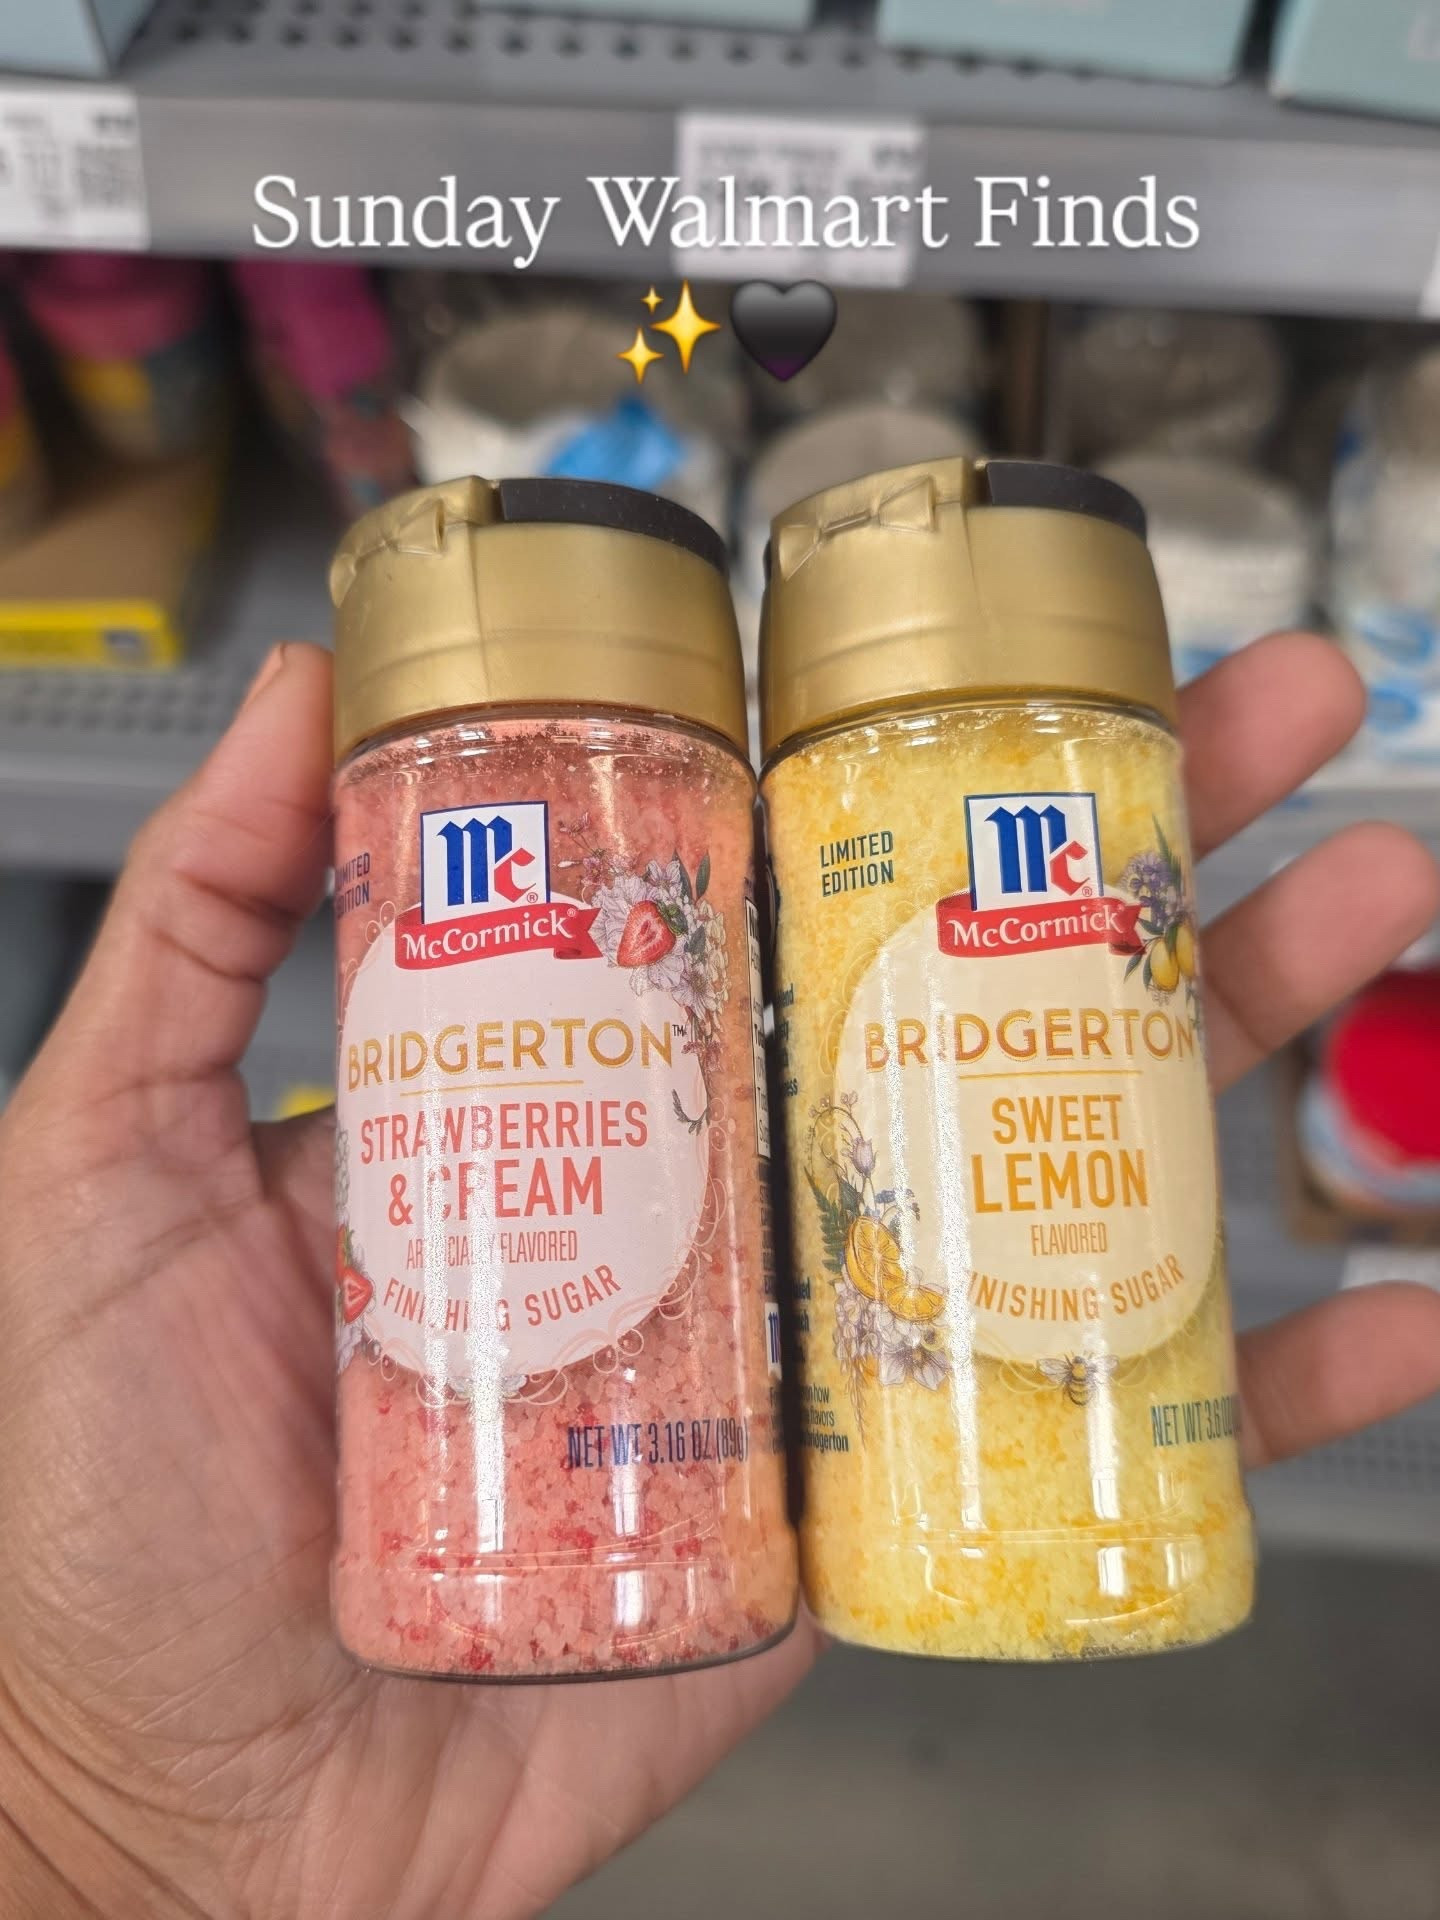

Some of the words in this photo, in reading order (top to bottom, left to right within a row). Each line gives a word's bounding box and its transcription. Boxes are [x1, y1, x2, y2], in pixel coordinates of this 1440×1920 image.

[819, 830, 895, 868] LIMITED
[822, 863, 895, 898] EDITION
[864, 1008, 1195, 1074] BRIDGERTON
[360, 1100, 648, 1165] STRAWBERRIES
[991, 1093, 1123, 1145] SWEET
[388, 1173, 414, 1227] &
[971, 1149, 1149, 1213] LEMON
[499, 1229, 578, 1265] FLAVORED
[1031, 1222, 1107, 1257] FLAVORED
[525, 1264, 621, 1326] SUGAR
[965, 1270, 1099, 1322] INISHING
[1112, 1254, 1185, 1314] SUGAR
[568, 1424, 604, 1468] NET
[611, 1423, 641, 1466] WT
[648, 1420, 685, 1464] 3.16
[691, 1418, 712, 1461] OZ
[715, 1416, 749, 1465] (89g)
[1151, 1404, 1178, 1447] NET
[1182, 1401, 1202, 1443] WT
[1205, 1398, 1221, 1440] 3.6
